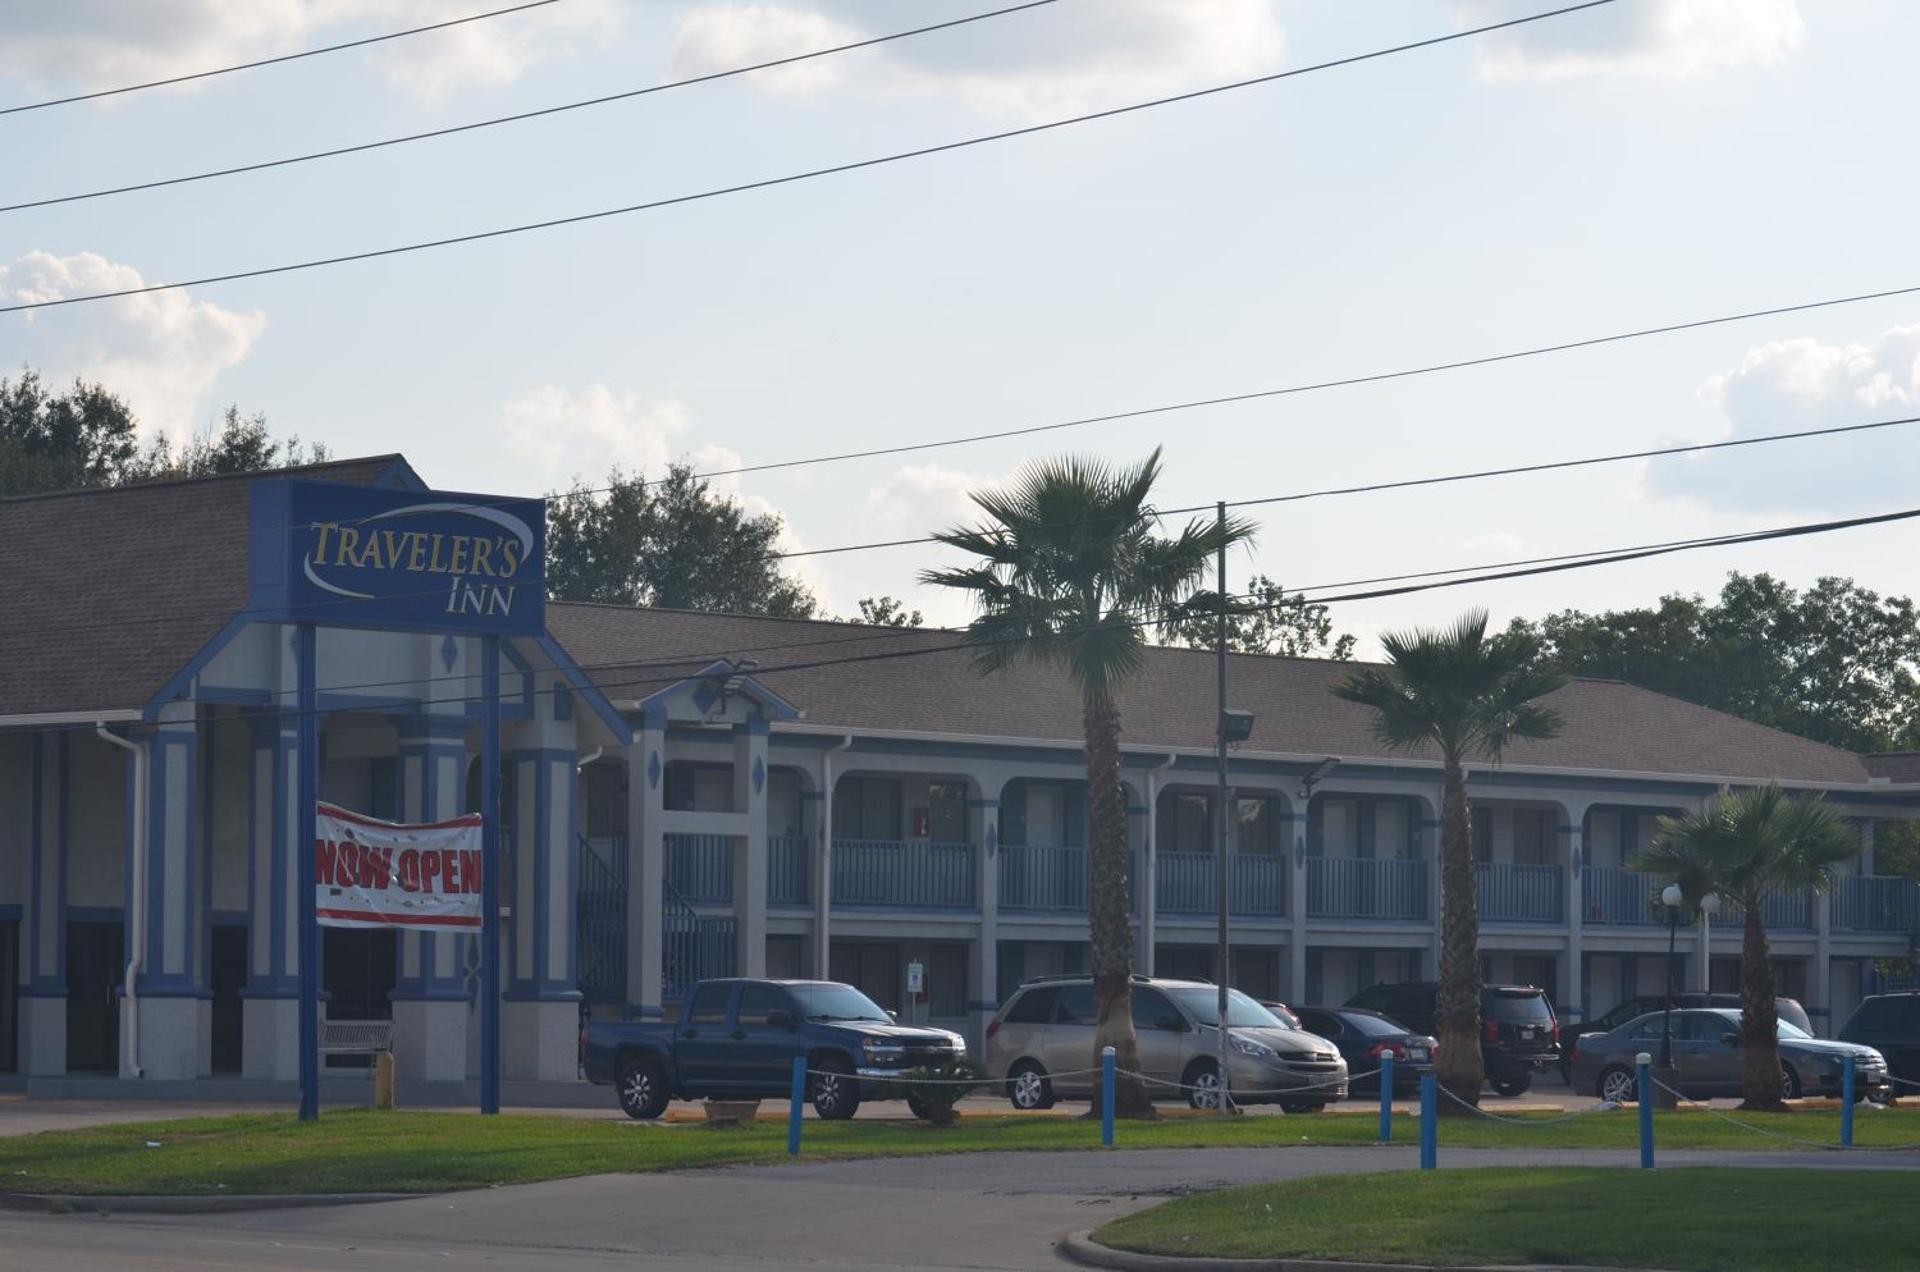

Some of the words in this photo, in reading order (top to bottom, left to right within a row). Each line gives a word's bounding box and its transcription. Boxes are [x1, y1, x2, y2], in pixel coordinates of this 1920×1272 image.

[310, 521, 519, 578] TRAVELER'S
[444, 576, 516, 616] INN
[316, 839, 393, 890] NOW
[398, 848, 482, 894] OPEN
